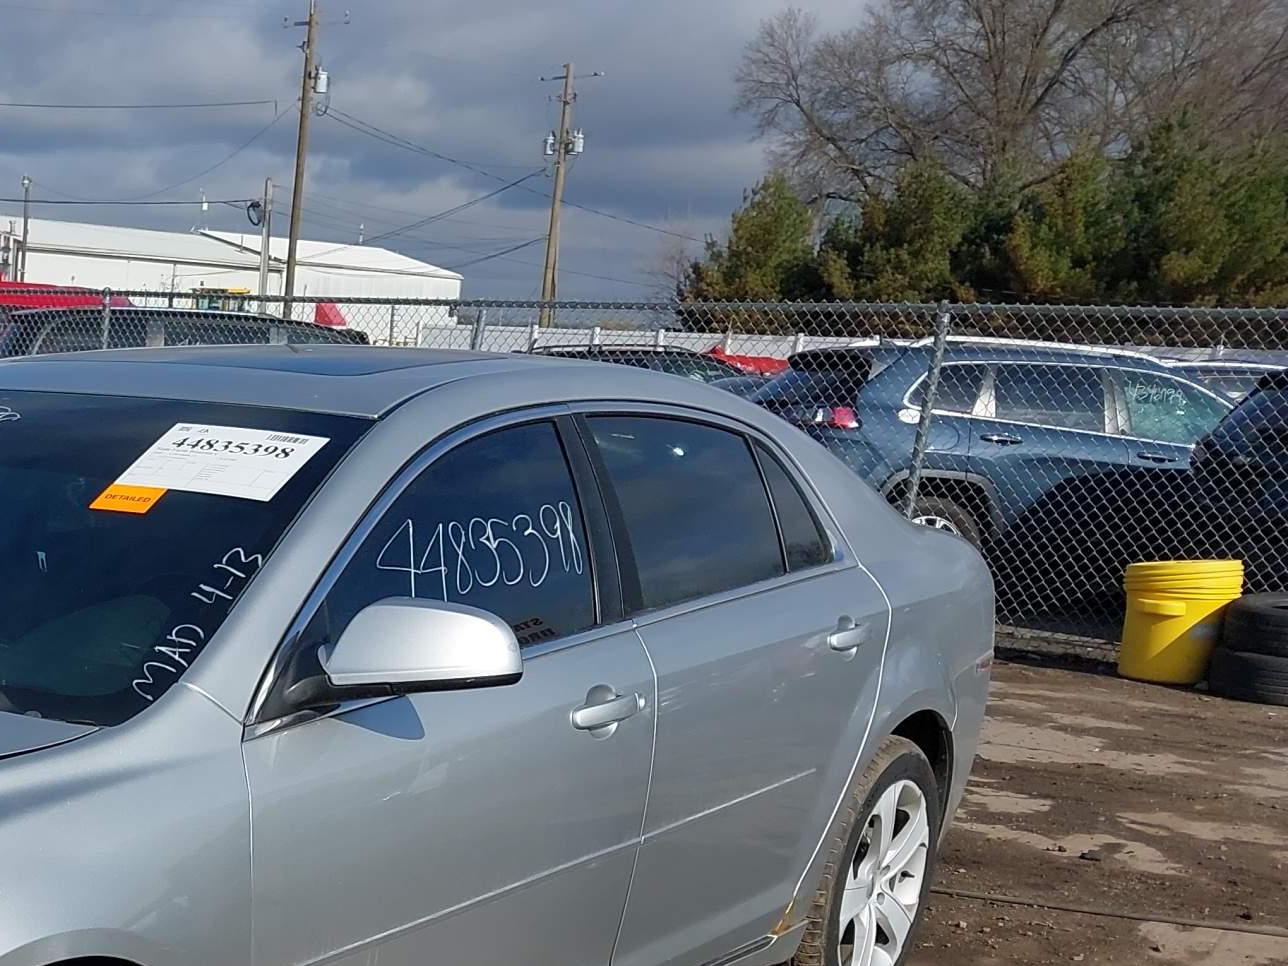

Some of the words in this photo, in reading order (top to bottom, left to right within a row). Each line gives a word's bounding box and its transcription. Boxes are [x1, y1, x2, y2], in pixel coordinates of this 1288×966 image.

[172, 436, 296, 460] 44835398
[104, 492, 152, 504] DETAILED
[376, 501, 583, 602] 44835398
[132, 624, 205, 701] MAD
[190, 547, 262, 604] 4-13
